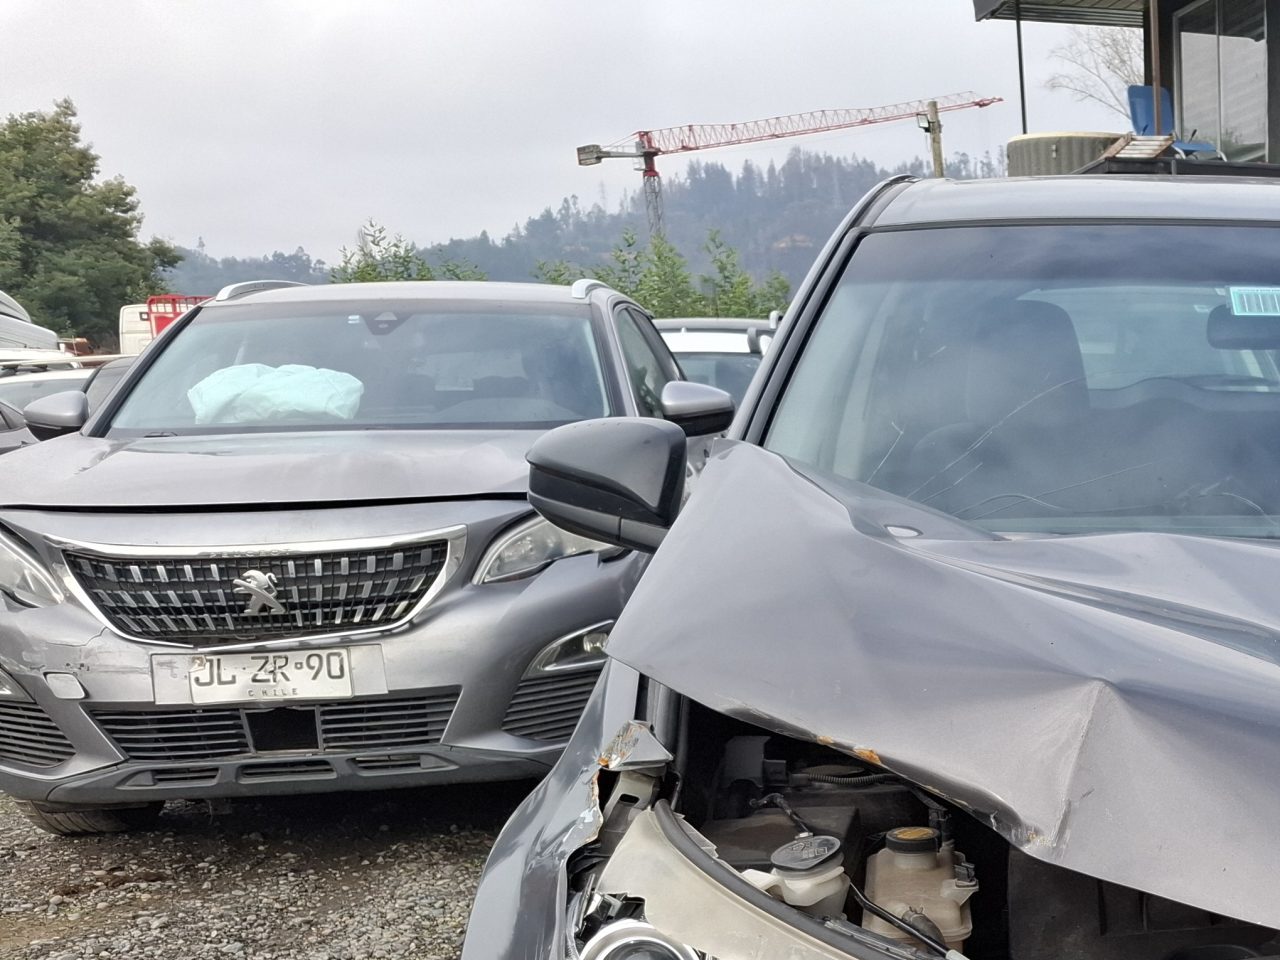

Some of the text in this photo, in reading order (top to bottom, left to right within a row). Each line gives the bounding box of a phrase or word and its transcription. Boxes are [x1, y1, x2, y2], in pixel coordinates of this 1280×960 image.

[195, 652, 344, 686] JL ZR 90
[248, 687, 299, 697] CHILE
